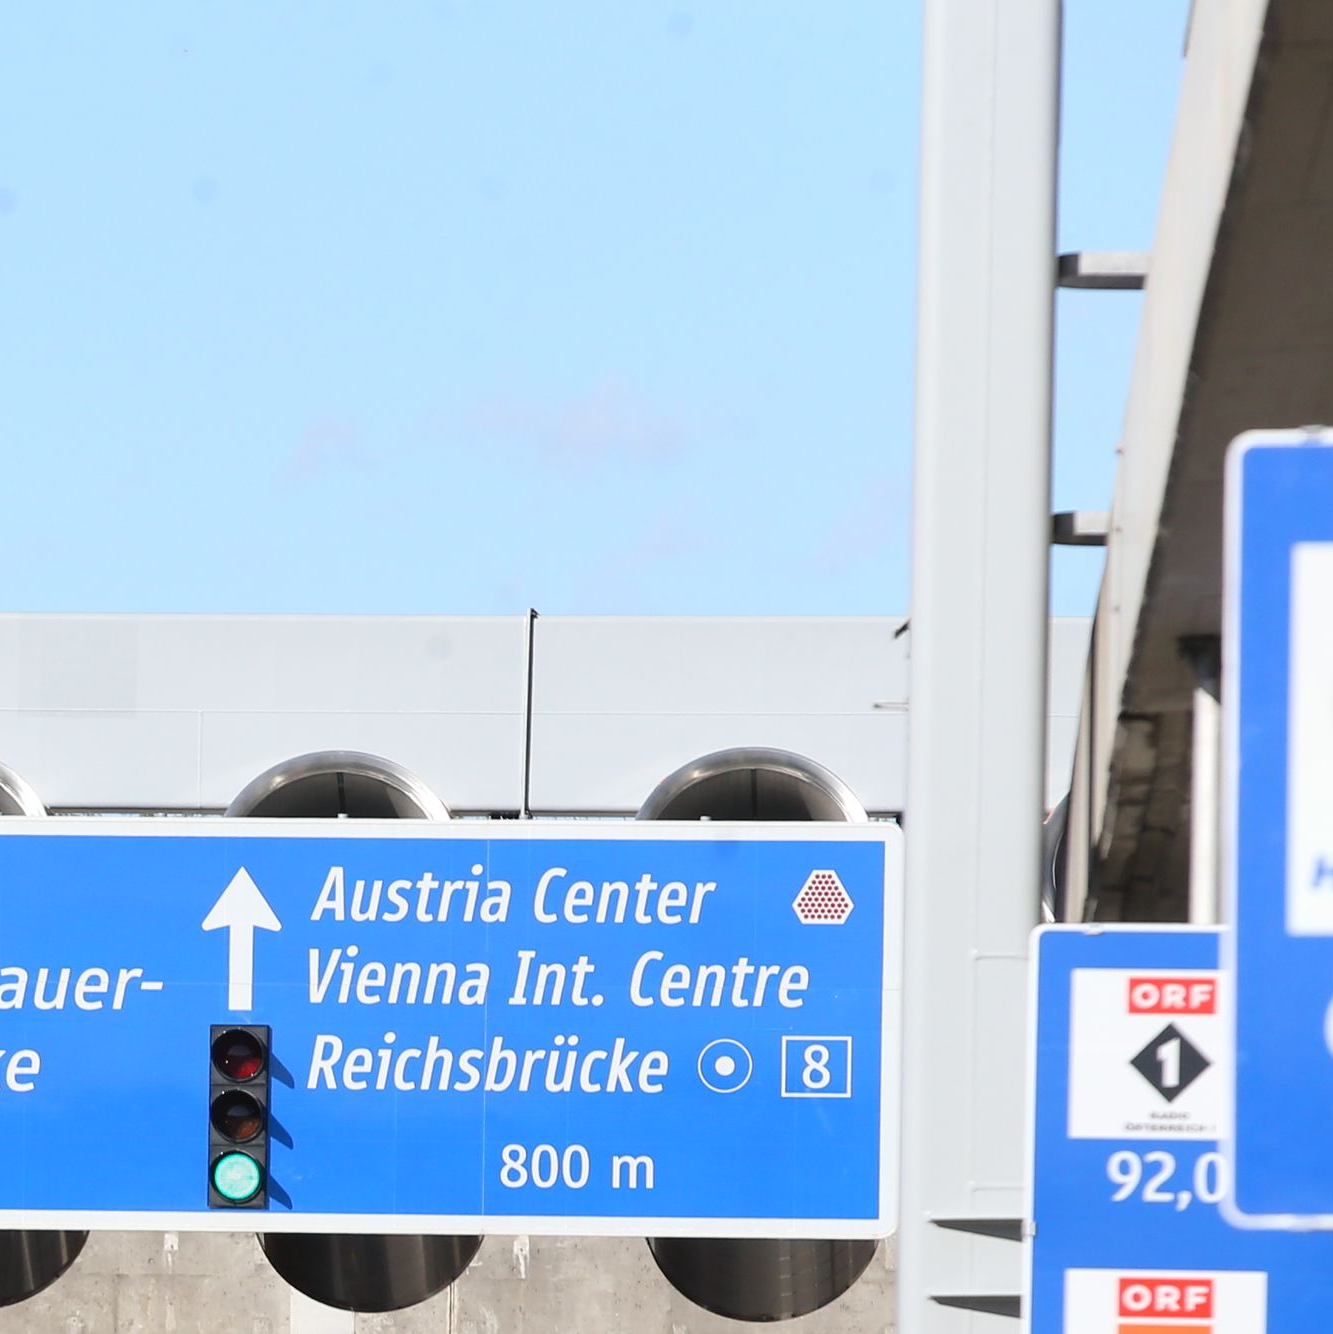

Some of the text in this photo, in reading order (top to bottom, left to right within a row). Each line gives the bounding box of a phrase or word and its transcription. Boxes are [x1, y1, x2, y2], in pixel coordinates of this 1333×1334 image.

[310, 863, 717, 925] Austria Center
[308, 945, 809, 1008] Vienna Int. Centre
[1132, 983, 1213, 1009] ORF
[306, 1031, 831, 1093] Reichsbrücke 8
[1156, 1036, 1181, 1089] 1
[500, 1143, 654, 1189] 800 m
[1106, 1149, 1229, 1212] 92,0
[1122, 1284, 1209, 1311] ORF
